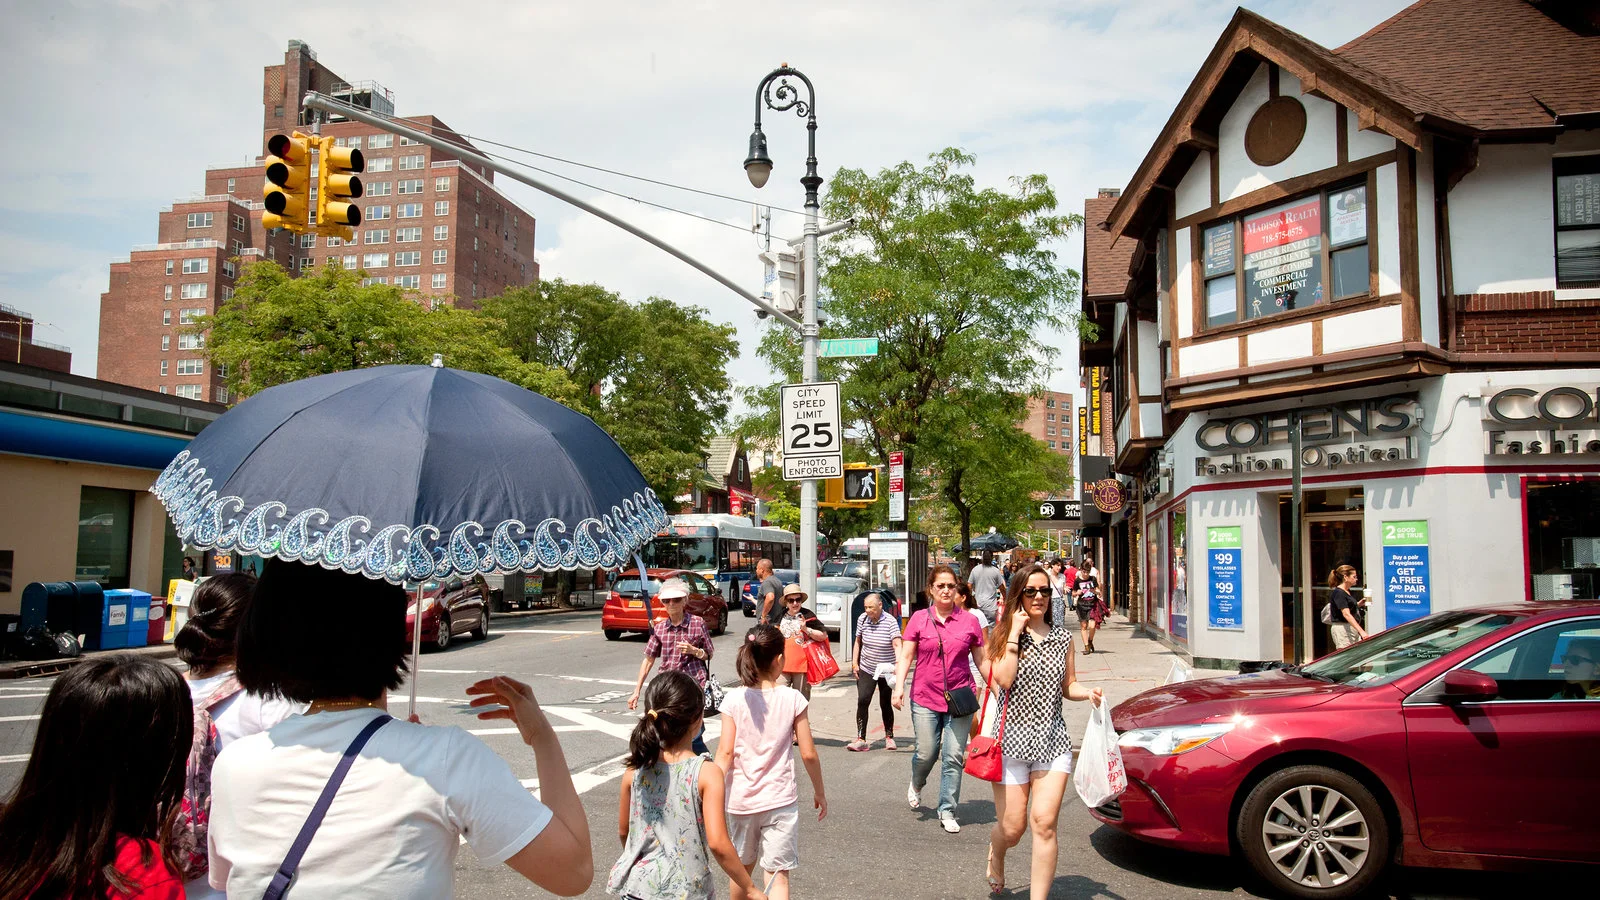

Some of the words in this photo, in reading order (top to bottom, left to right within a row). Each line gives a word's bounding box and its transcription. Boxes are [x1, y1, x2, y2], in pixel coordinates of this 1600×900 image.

[1575, 198, 1584, 221] RENT
[1246, 219, 1283, 235] MADISON
[1285, 207, 1318, 224] REALTY
[1262, 226, 1303, 244] 718-575-0575
[1259, 270, 1308, 288] COMMERCIAL
[1261, 279, 1307, 297] INVESTMENT
[822, 341, 866, 355] AUSTIN
[797, 388, 820, 398] CITY
[1092, 388, 1100, 409] WILD
[792, 399, 826, 409] SPEED
[1488, 386, 1600, 424] CO
[796, 410, 823, 420] LIMIT
[1092, 410, 1100, 434] WINGS
[1196, 398, 1410, 451] COHEN'S
[790, 422, 833, 449] 25
[797, 458, 827, 467] PHOTO
[1195, 453, 1283, 476] Fashion
[1300, 435, 1413, 469] Optical
[789, 466, 836, 476] ENFORCED
[1210, 530, 1217, 543] 2
[1386, 525, 1396, 539] 2
[1214, 553, 1233, 564] $99
[1396, 568, 1415, 576] GET
[1215, 582, 1234, 594] $99
[1388, 585, 1402, 593] 2ND
[1404, 585, 1426, 593] PAIR
